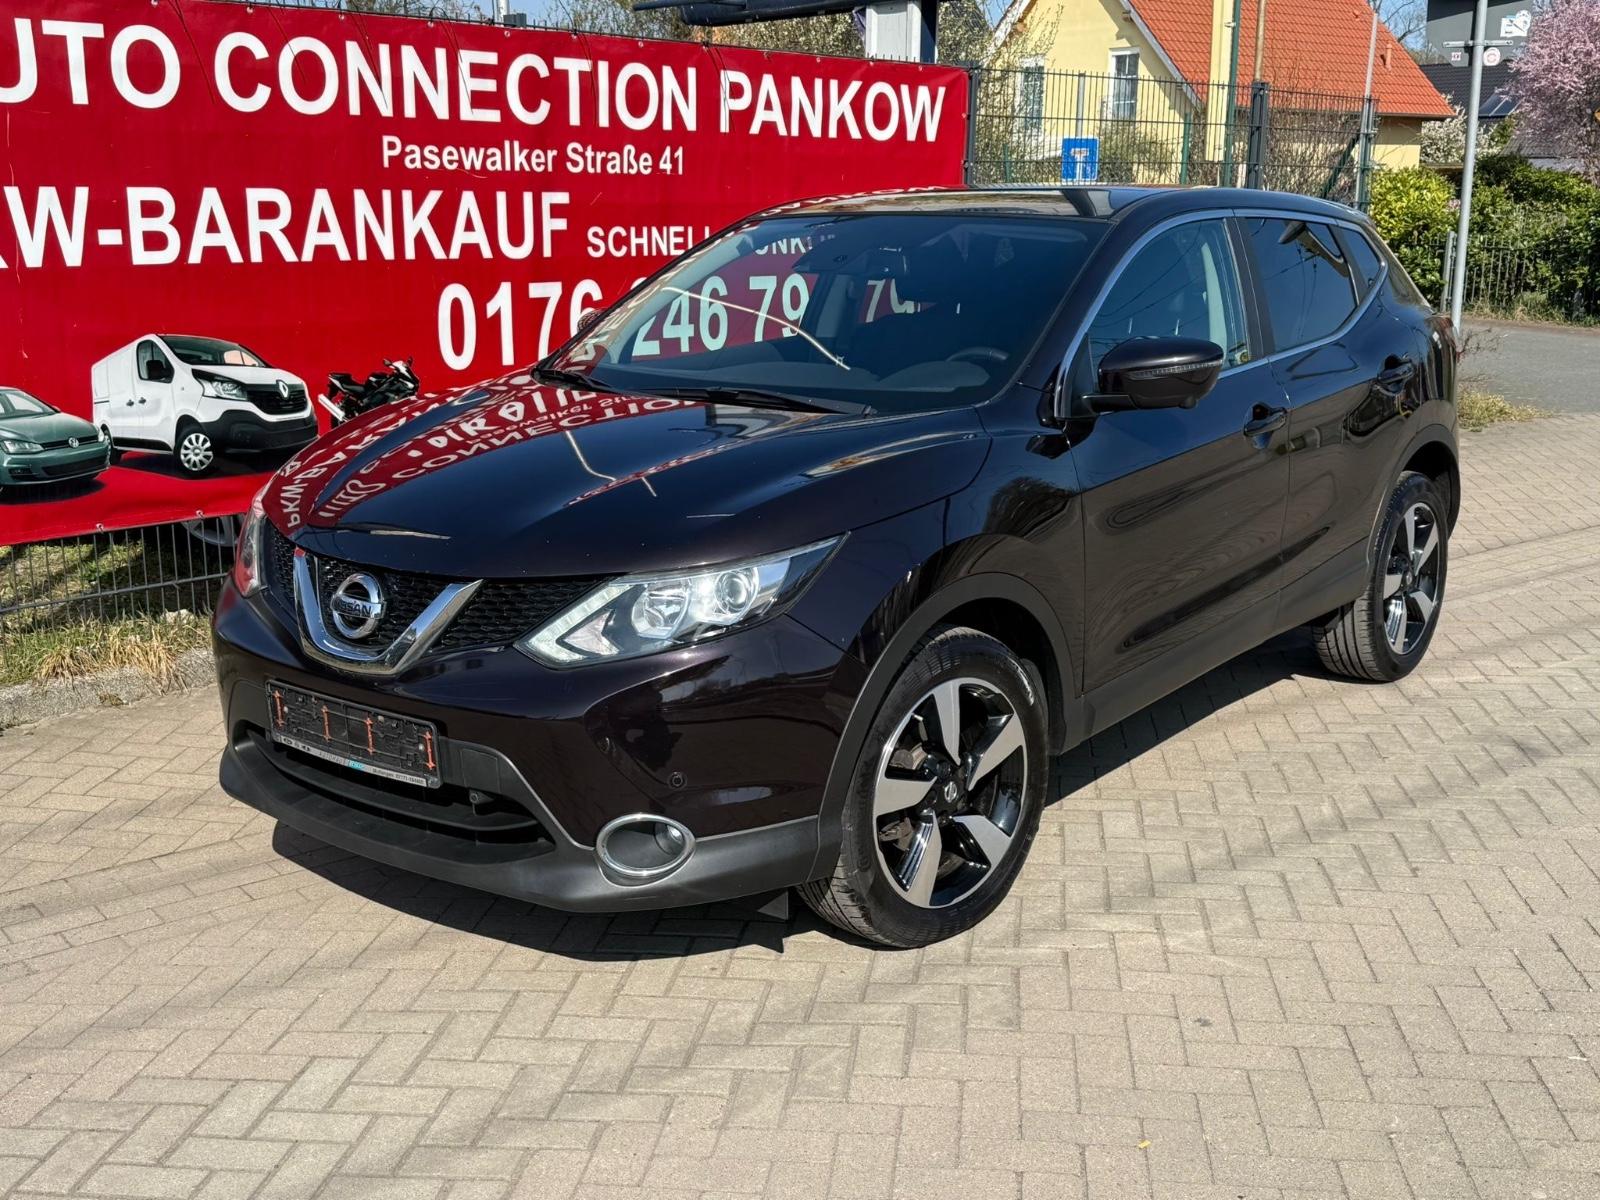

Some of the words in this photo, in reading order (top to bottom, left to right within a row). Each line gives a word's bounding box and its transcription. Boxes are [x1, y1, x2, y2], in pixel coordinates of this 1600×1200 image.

[214, 31, 697, 132] CONNECTION
[719, 69, 946, 142] PANKOW
[383, 135, 558, 173] Pasewalker
[566, 142, 653, 175] Straße
[659, 146, 683, 175] 41
[0, 186, 570, 269] W-BARANKAUF
